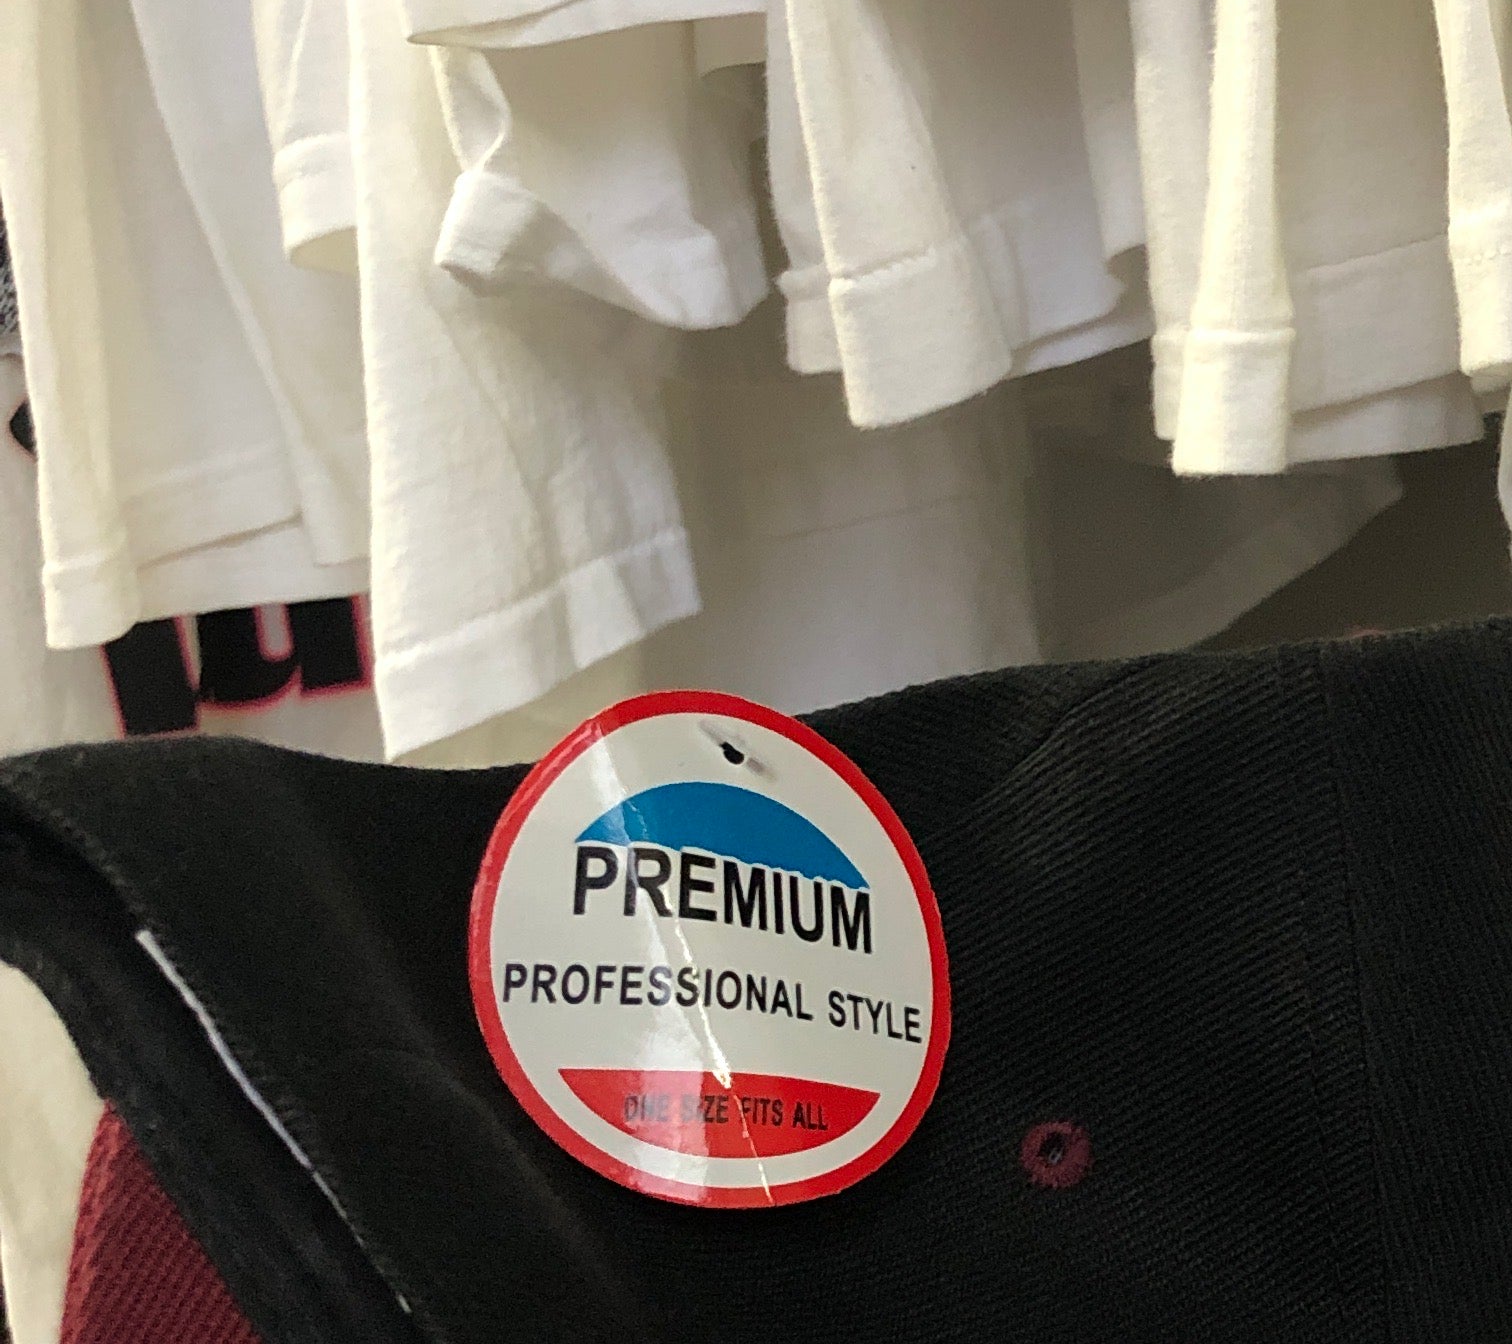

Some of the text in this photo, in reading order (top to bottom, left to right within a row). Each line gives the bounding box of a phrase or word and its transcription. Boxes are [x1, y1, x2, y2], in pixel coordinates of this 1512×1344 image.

[572, 845, 874, 955] PREMIUM
[501, 963, 924, 1044] PROFESSIONAL STYLE
[624, 1093, 829, 1131] ONE SIZE FITS ALL
